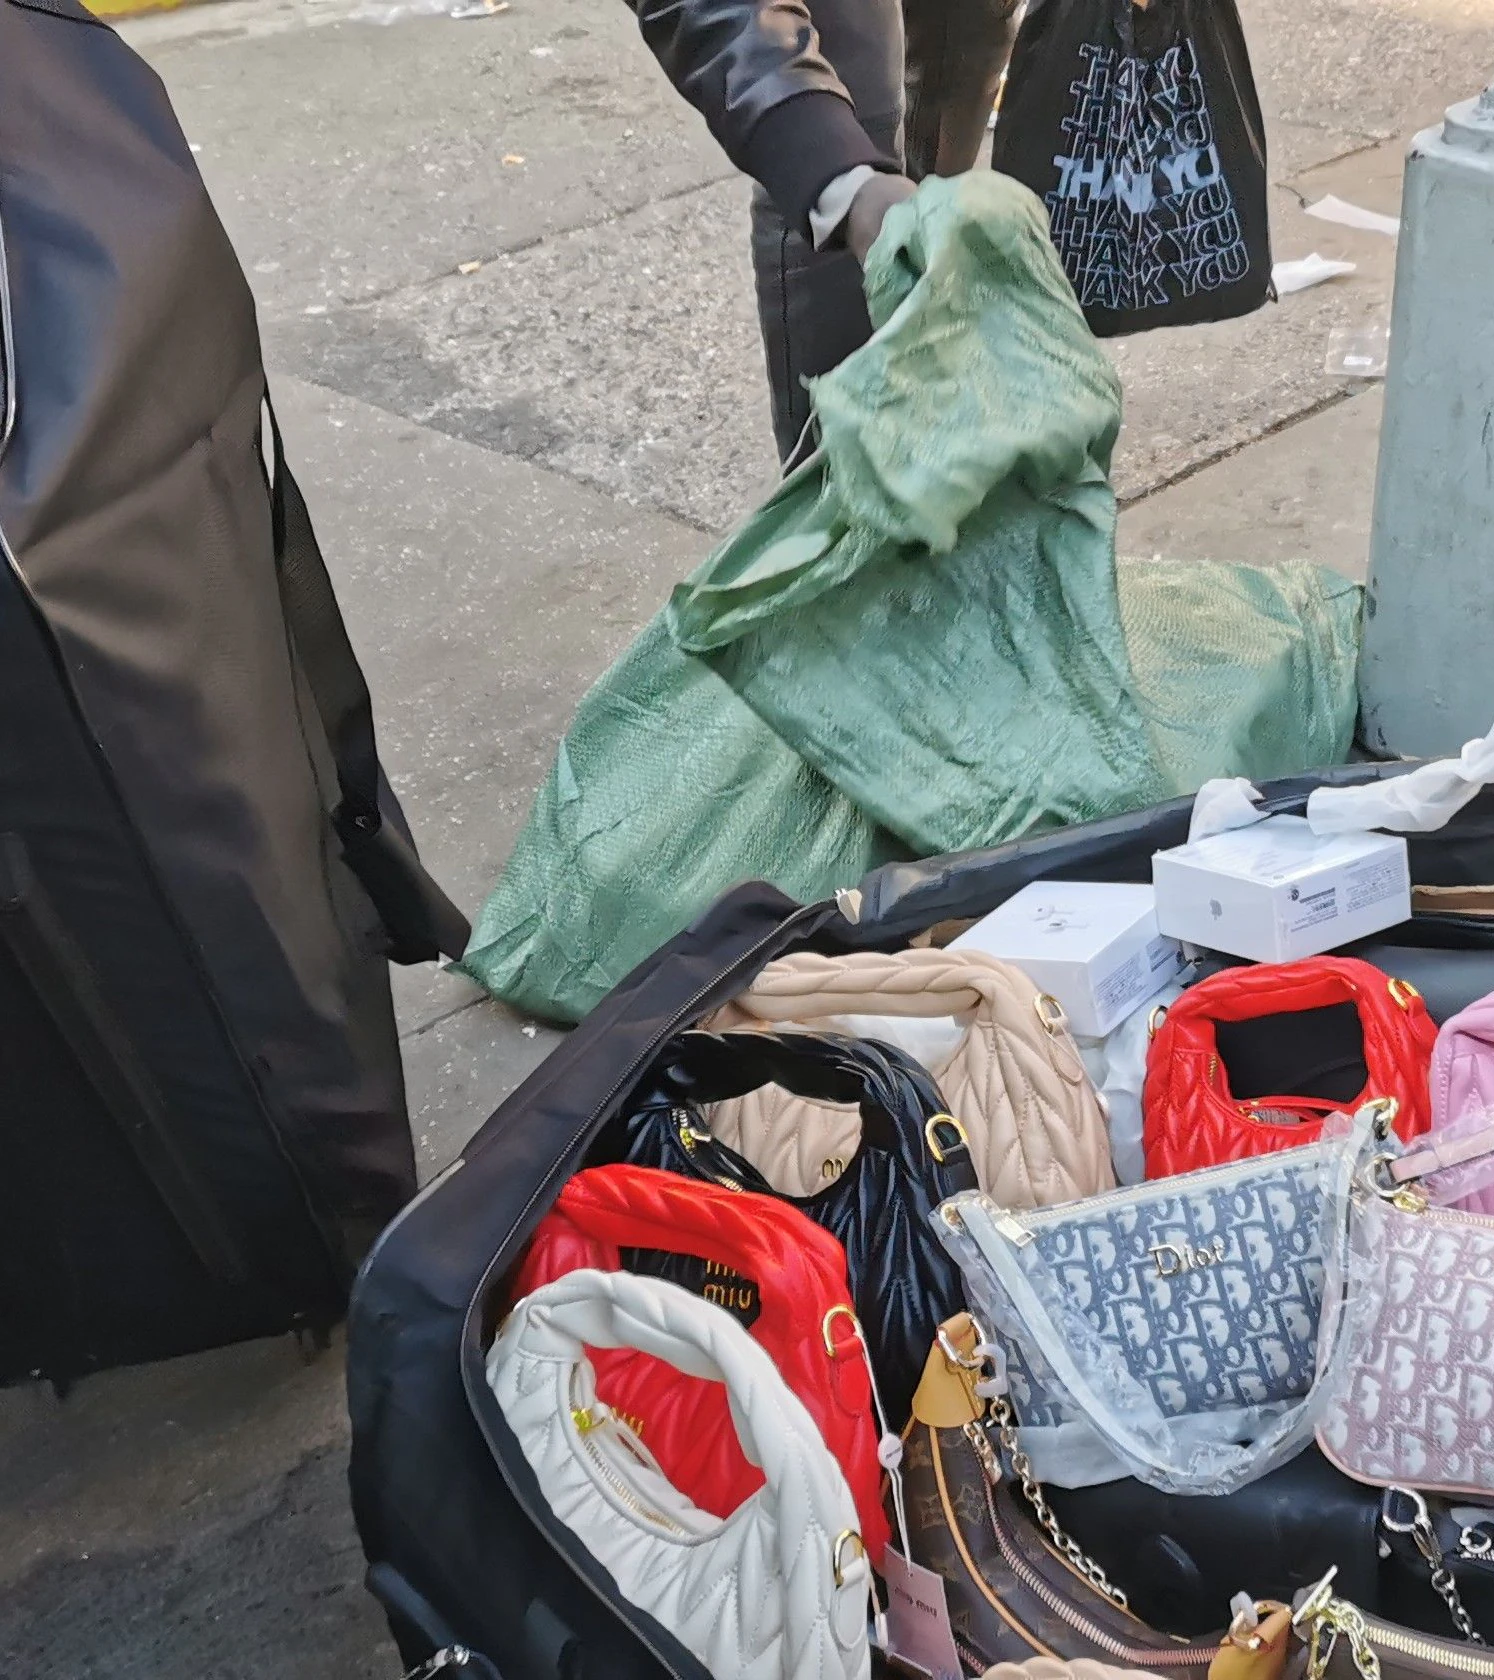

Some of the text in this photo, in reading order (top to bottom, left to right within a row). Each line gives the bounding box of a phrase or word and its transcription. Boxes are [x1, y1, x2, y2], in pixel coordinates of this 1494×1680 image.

[1169, 241, 1250, 297] YOU
[1148, 1242, 1225, 1276] Dior
[704, 1283, 752, 1309] miu
